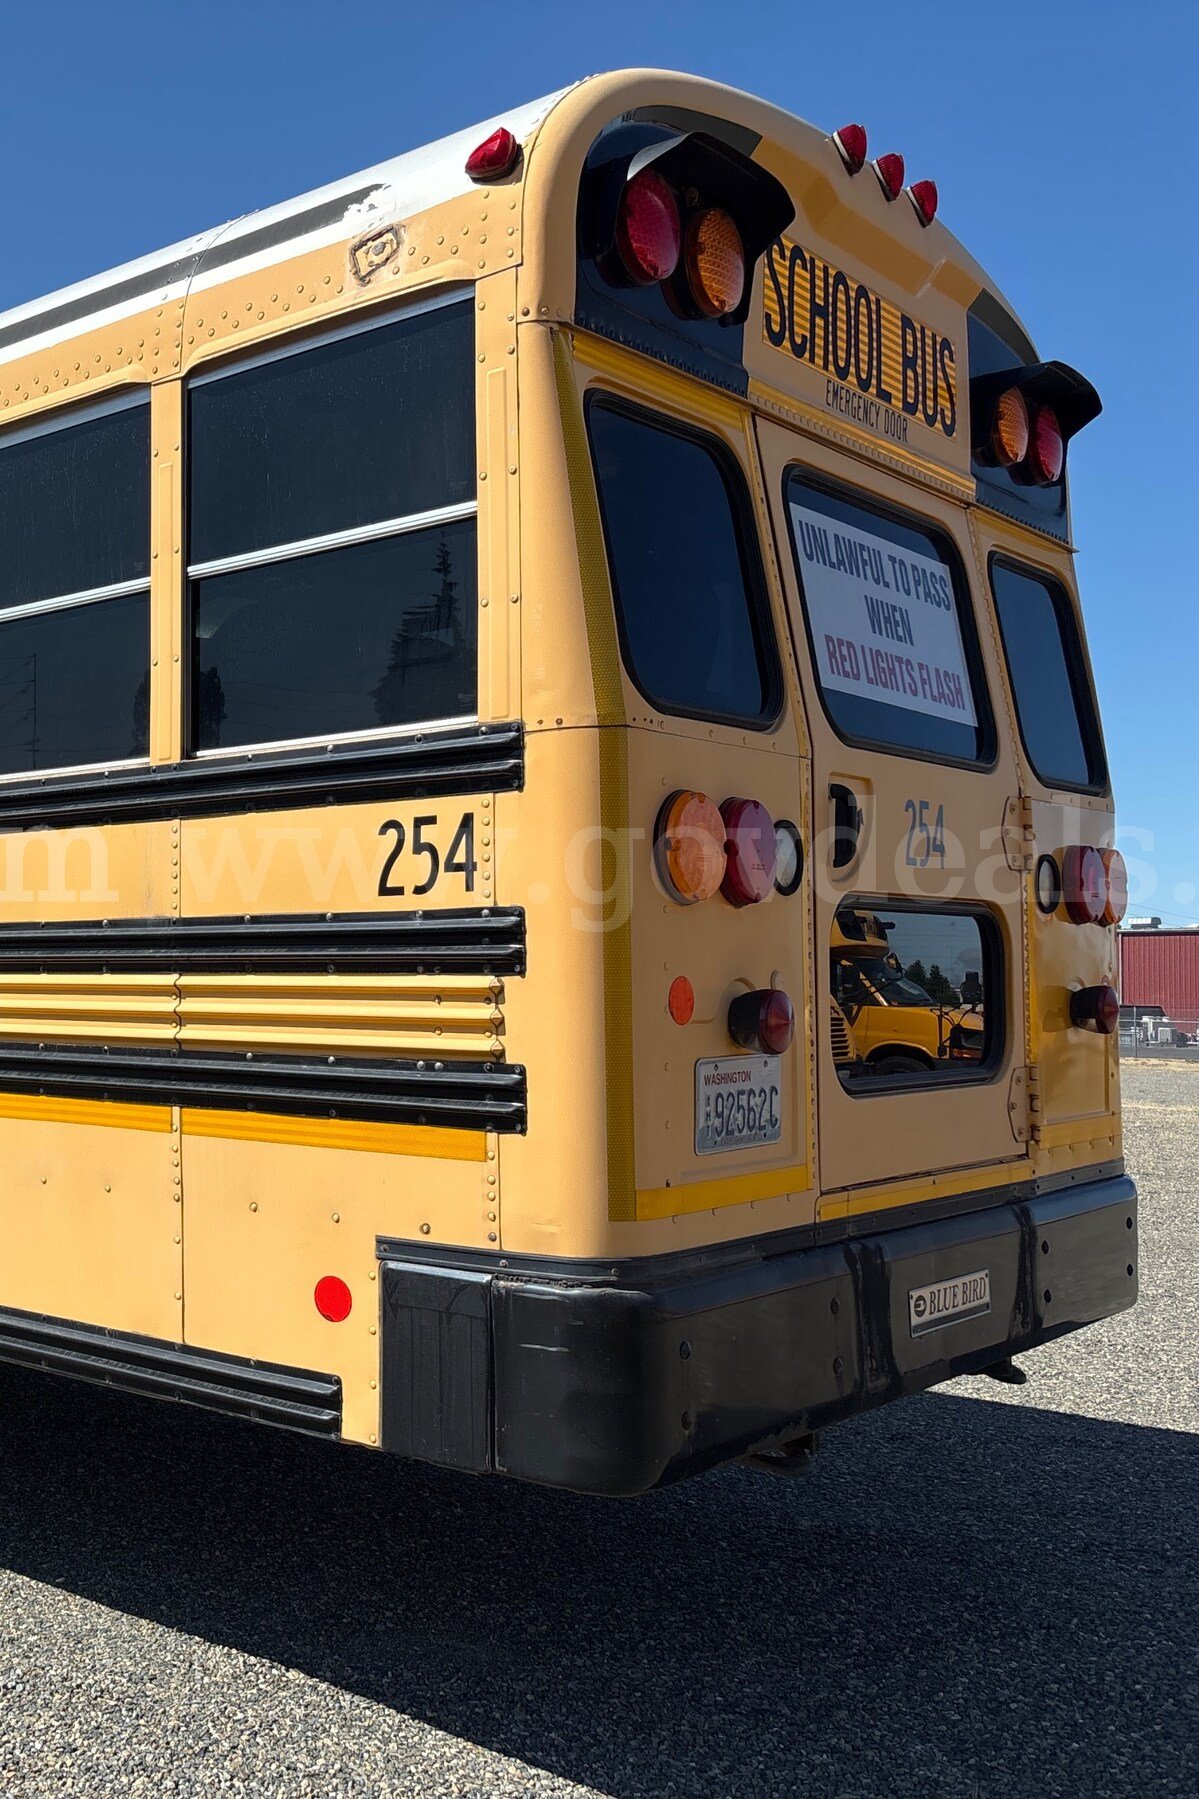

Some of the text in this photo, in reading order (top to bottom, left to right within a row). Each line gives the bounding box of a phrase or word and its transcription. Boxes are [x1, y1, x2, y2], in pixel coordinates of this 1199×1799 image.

[765, 233, 956, 437] SCHOOL BUS
[825, 379, 908, 443] EMERGENCY DOOR
[798, 519, 951, 611] UNLAWFUL TO PASS
[864, 595, 914, 646] WHEN
[824, 634, 966, 710] RED LIGHTS FLASH
[377, 812, 477, 897] 254
[904, 799, 946, 869] 254
[703, 1070, 752, 1086] WASHINGTON
[715, 1085, 779, 1138] 92562C
[928, 1276, 987, 1315] BLUE BIRD
